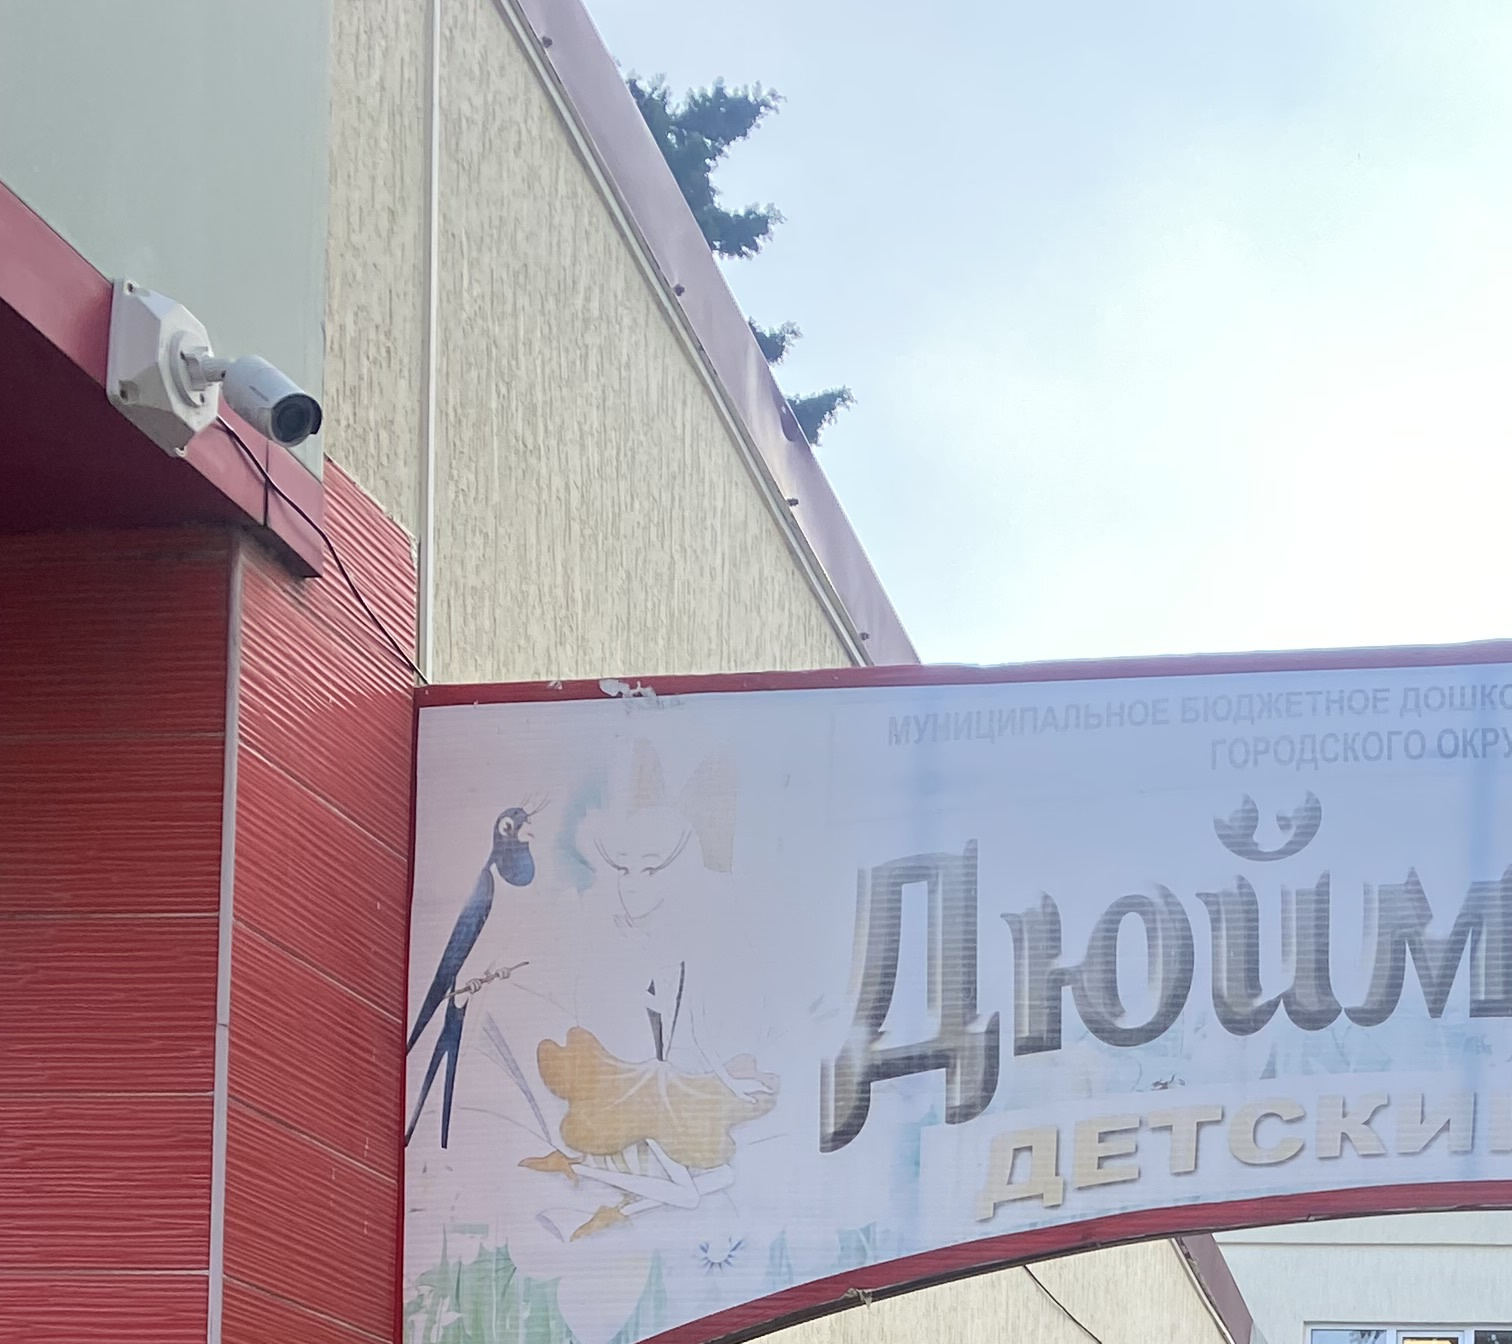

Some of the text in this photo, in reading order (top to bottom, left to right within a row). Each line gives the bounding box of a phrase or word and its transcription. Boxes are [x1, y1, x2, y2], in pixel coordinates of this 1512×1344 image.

[887, 697, 1170, 747] МУНИЦИПАЛЬНОЕ
[1180, 687, 1391, 726] БЮДЖЕТНОЕ
[1209, 727, 1427, 772] ГОРОДСКОГО
